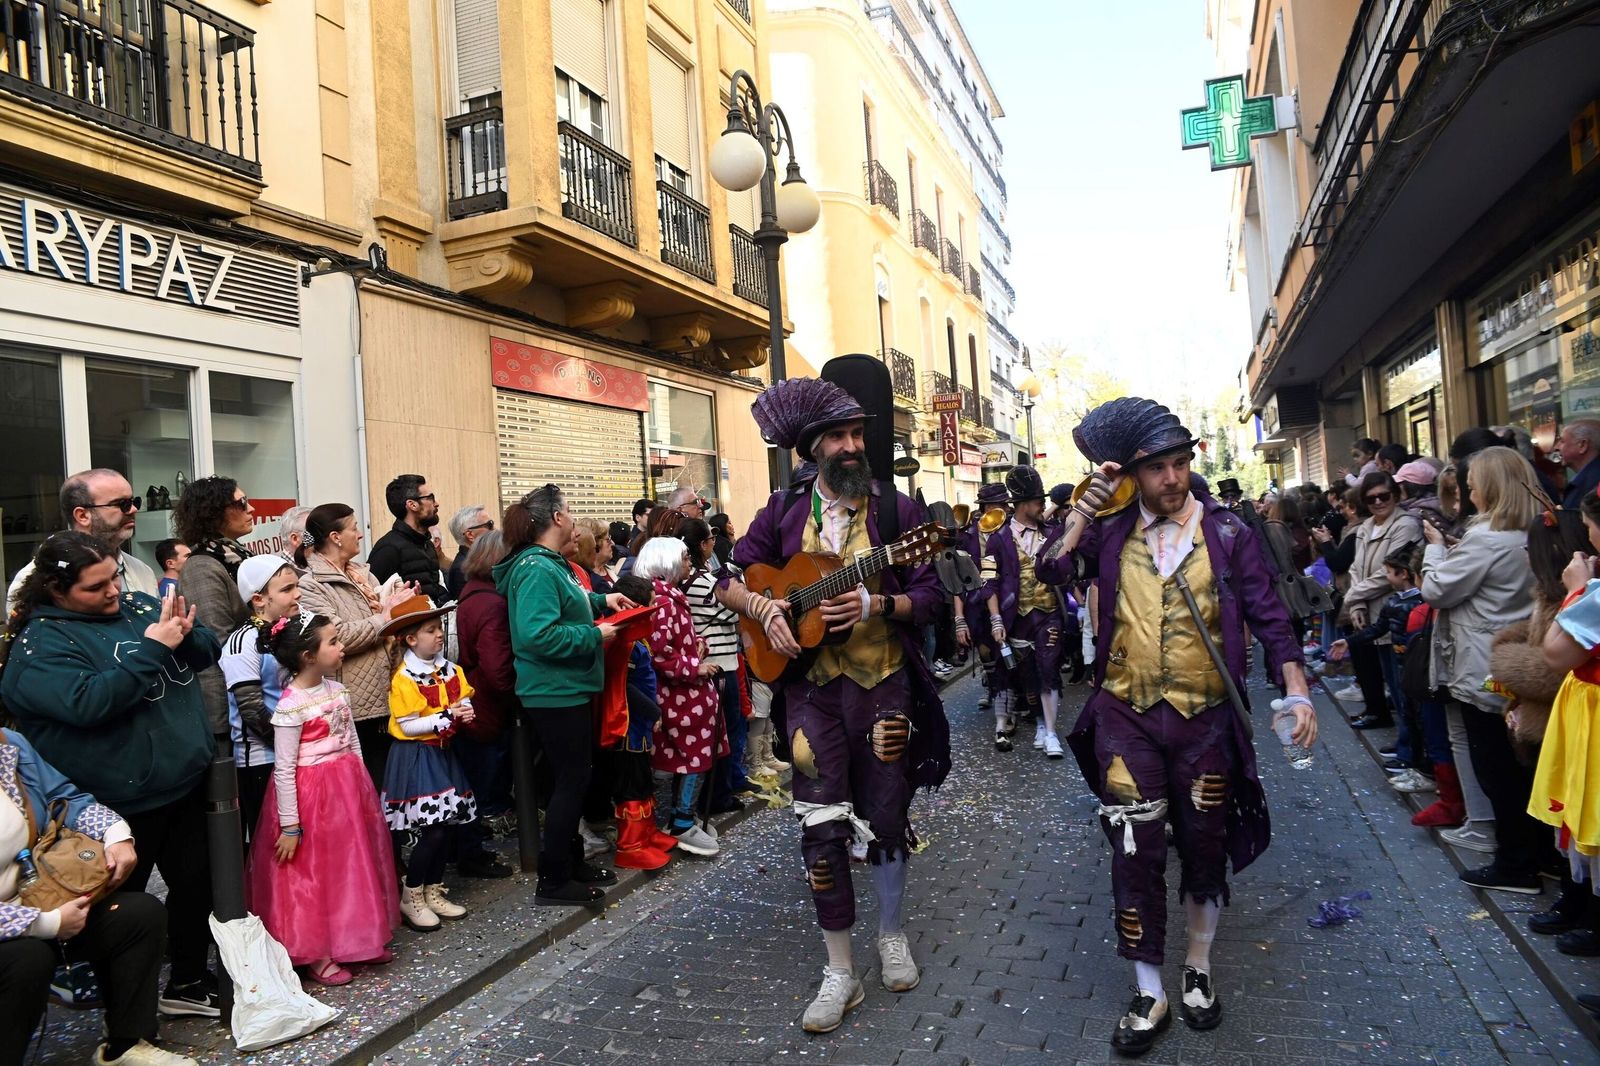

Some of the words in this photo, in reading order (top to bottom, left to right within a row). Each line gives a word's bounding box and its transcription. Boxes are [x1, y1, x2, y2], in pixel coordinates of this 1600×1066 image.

[937, 402, 960, 410] REGALOS
[942, 412, 956, 463] YARO
[244, 538, 272, 555] MOS
